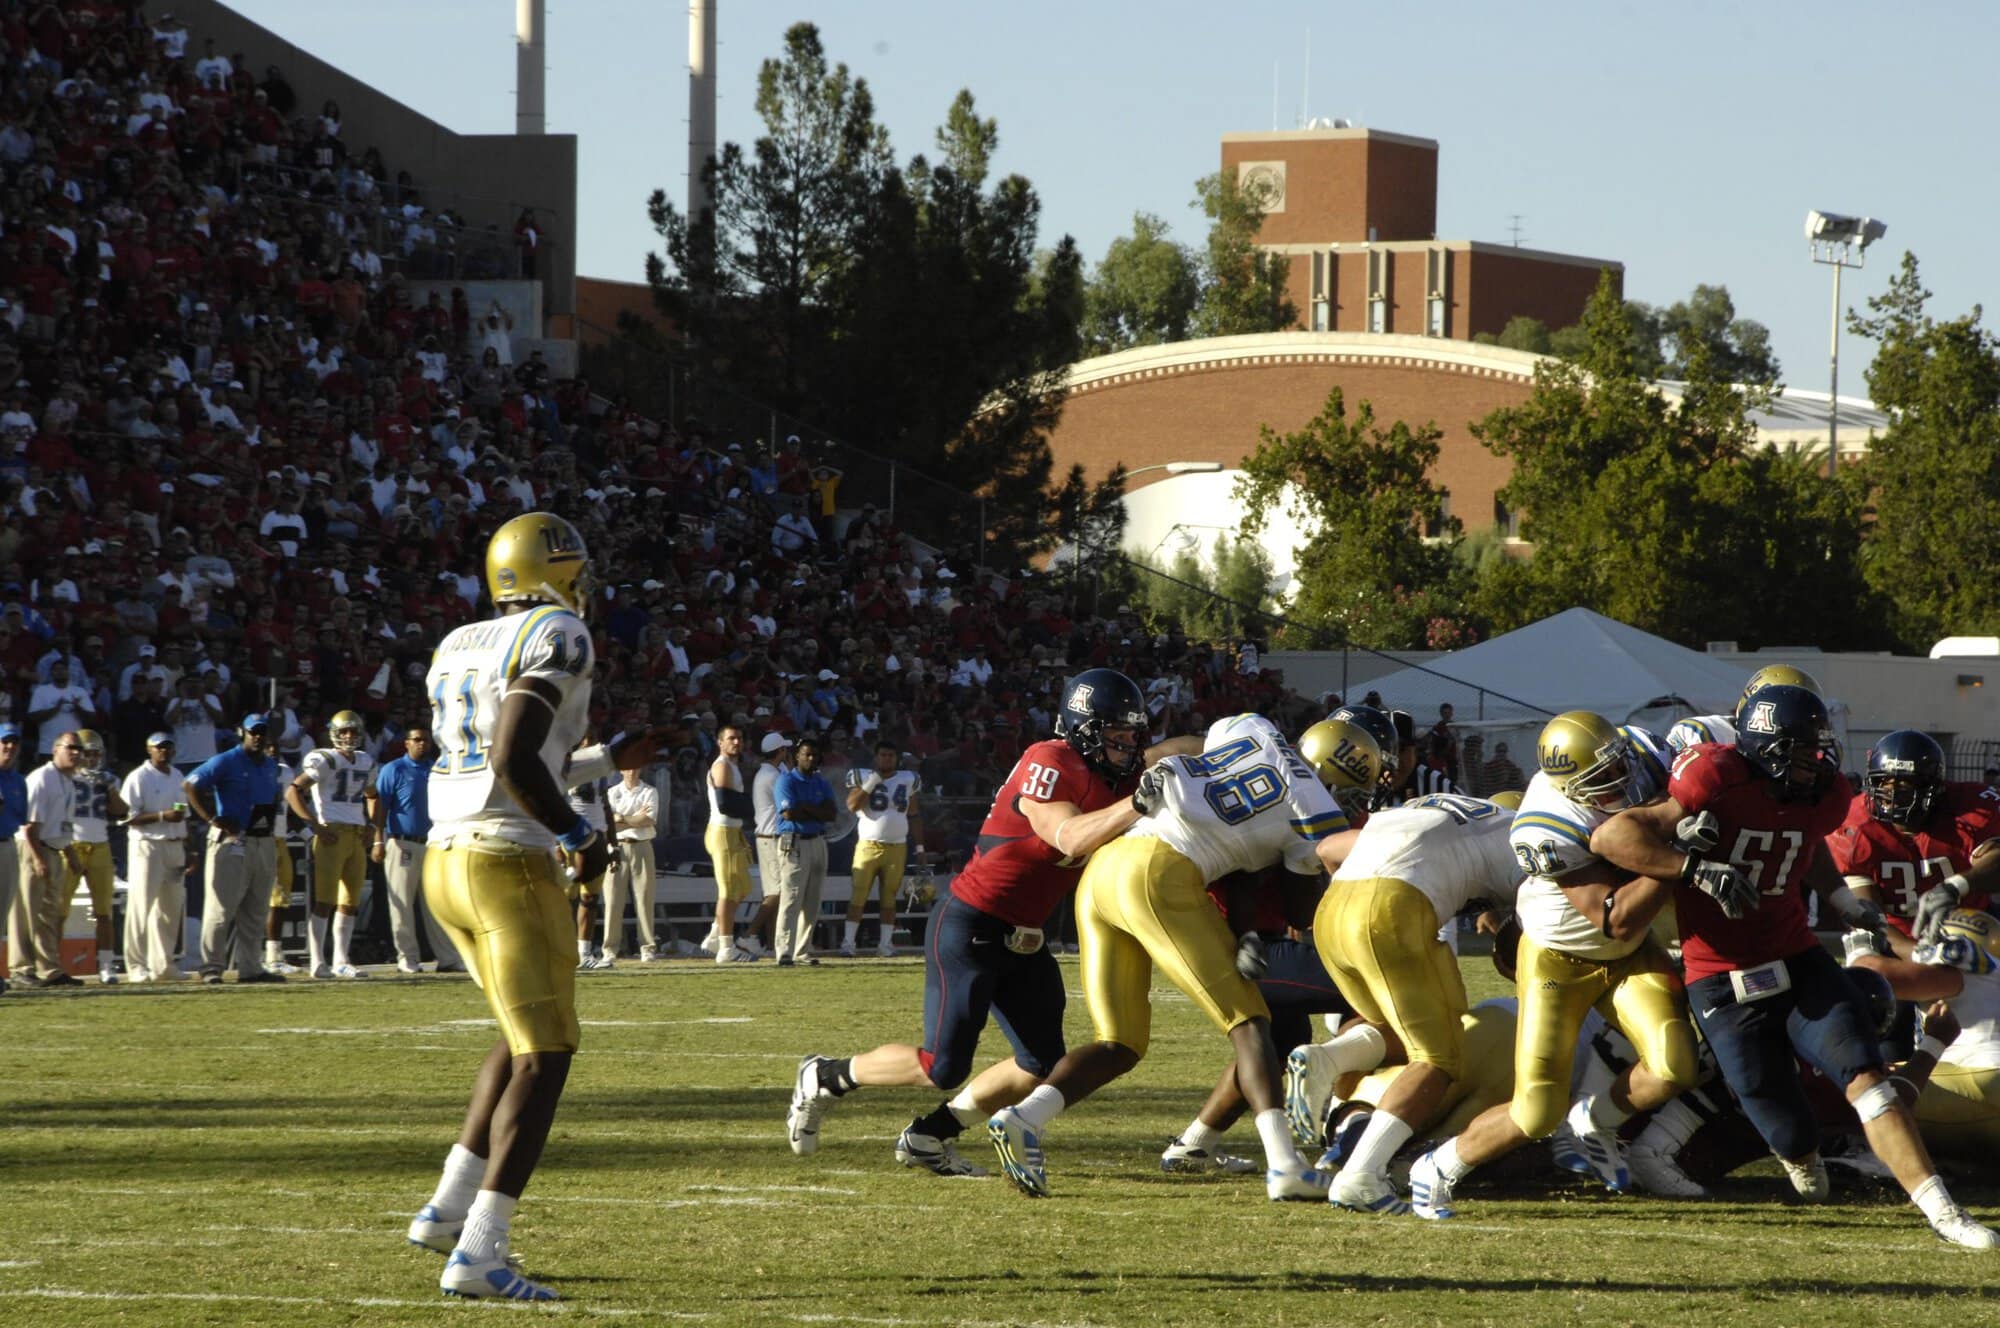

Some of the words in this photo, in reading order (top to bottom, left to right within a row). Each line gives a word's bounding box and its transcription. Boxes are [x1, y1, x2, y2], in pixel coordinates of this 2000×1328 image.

[1067, 683, 1095, 716] A
[1747, 701, 1777, 735] A
[431, 669, 490, 774] 11
[1326, 737, 1371, 784] Ucla
[1538, 744, 1578, 775] Ucla
[869, 783, 908, 813] 64
[1021, 762, 1060, 800] 39
[1179, 736, 1289, 826] 48
[1514, 839, 1568, 876] 31
